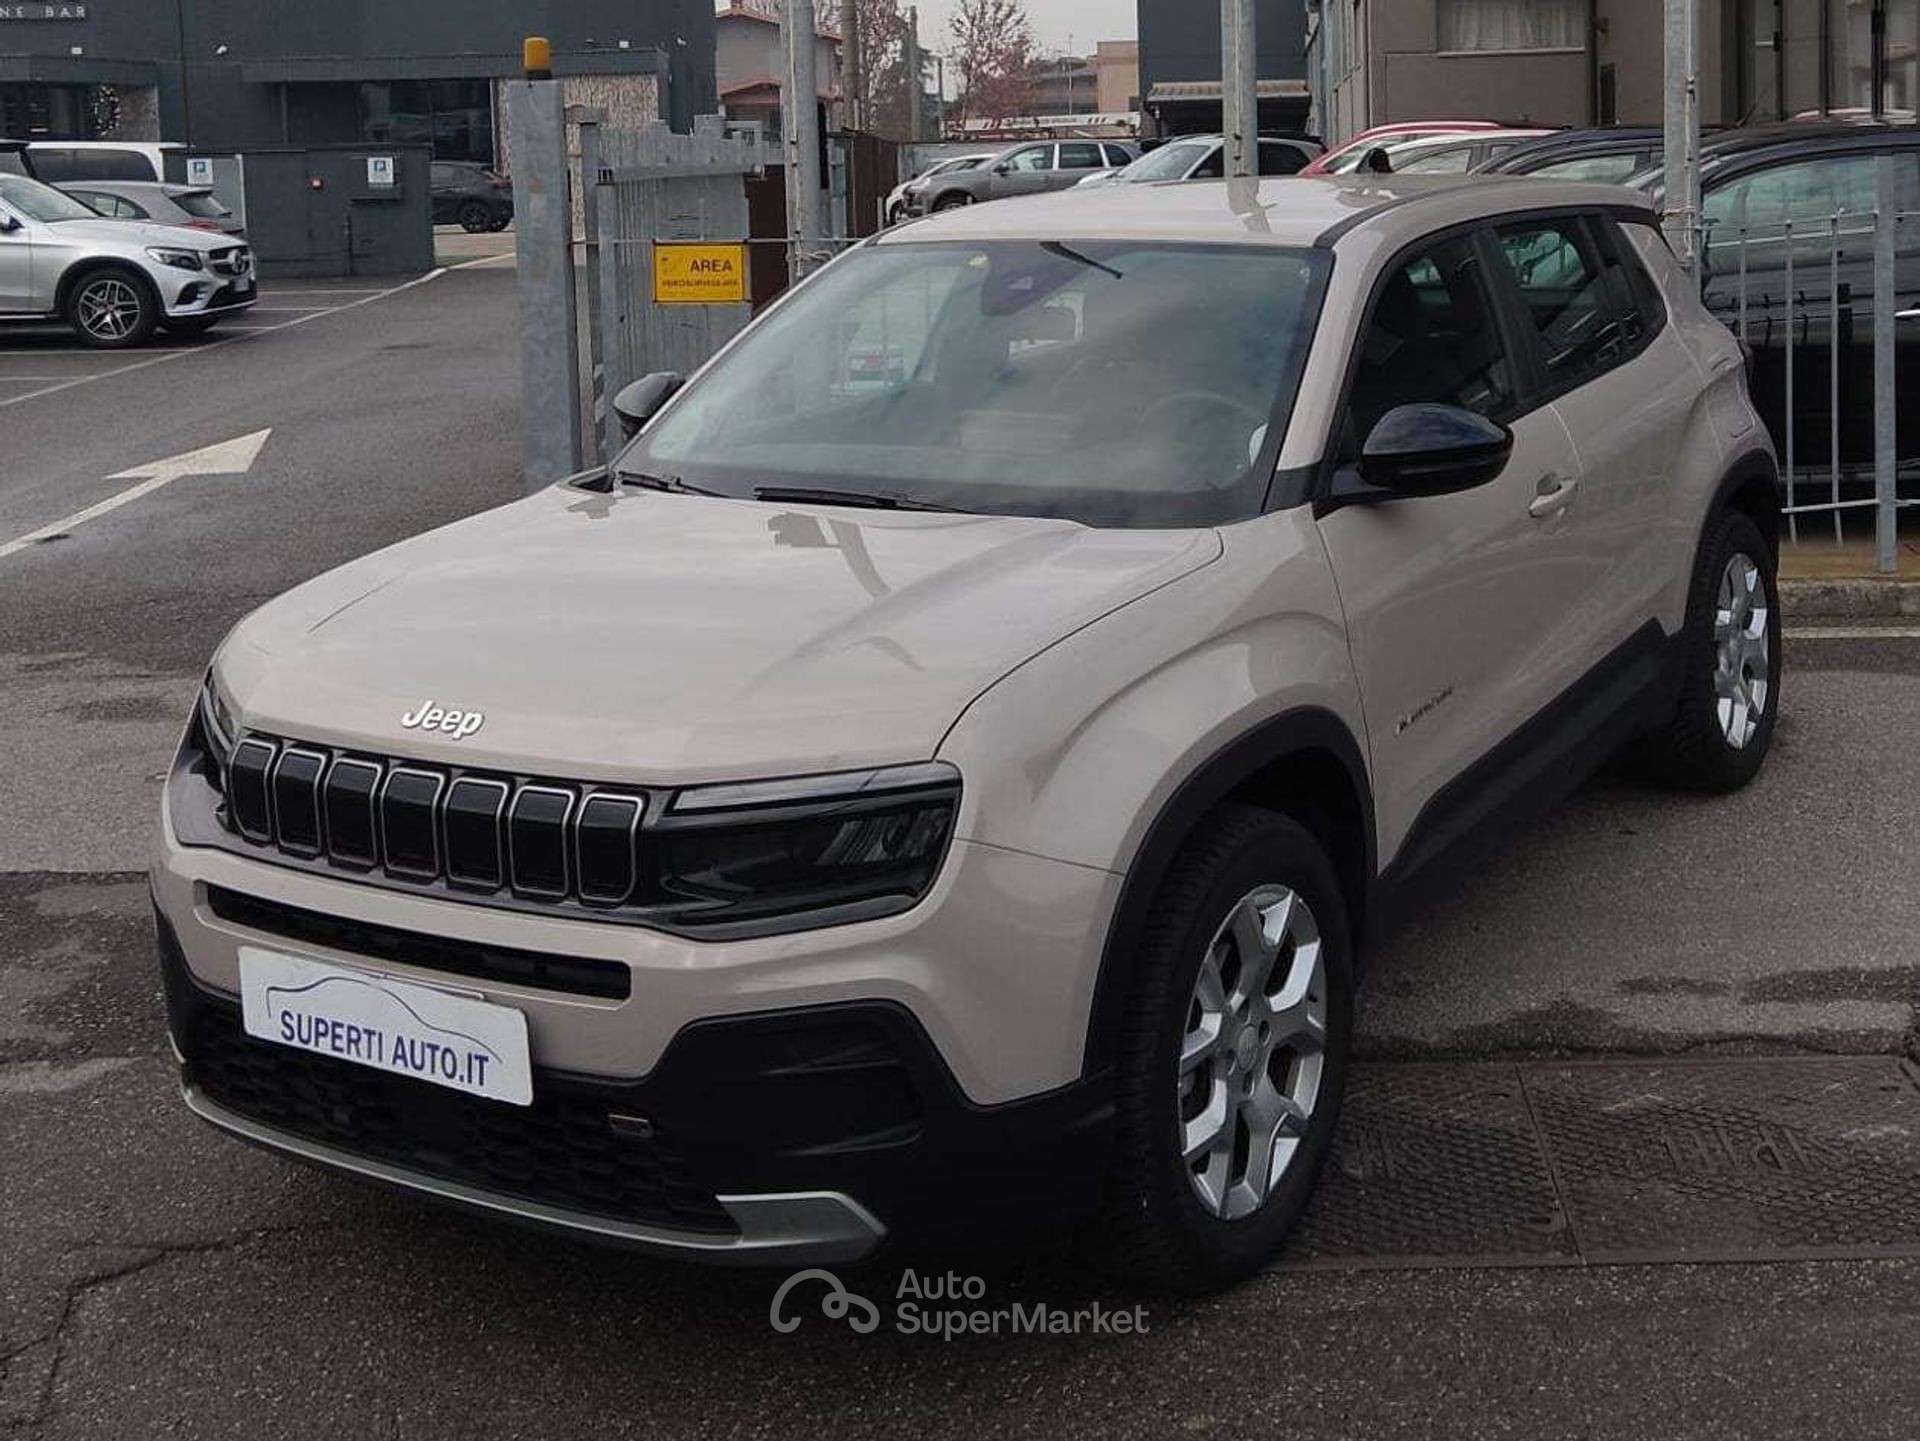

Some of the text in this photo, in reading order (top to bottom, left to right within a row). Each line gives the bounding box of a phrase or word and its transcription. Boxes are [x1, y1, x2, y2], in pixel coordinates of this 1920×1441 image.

[45, 6, 86, 18] BAR
[690, 260, 732, 273] AREA
[401, 700, 484, 740] Jeep
[280, 1009, 490, 1086] SUPERTI AUTO.IT
